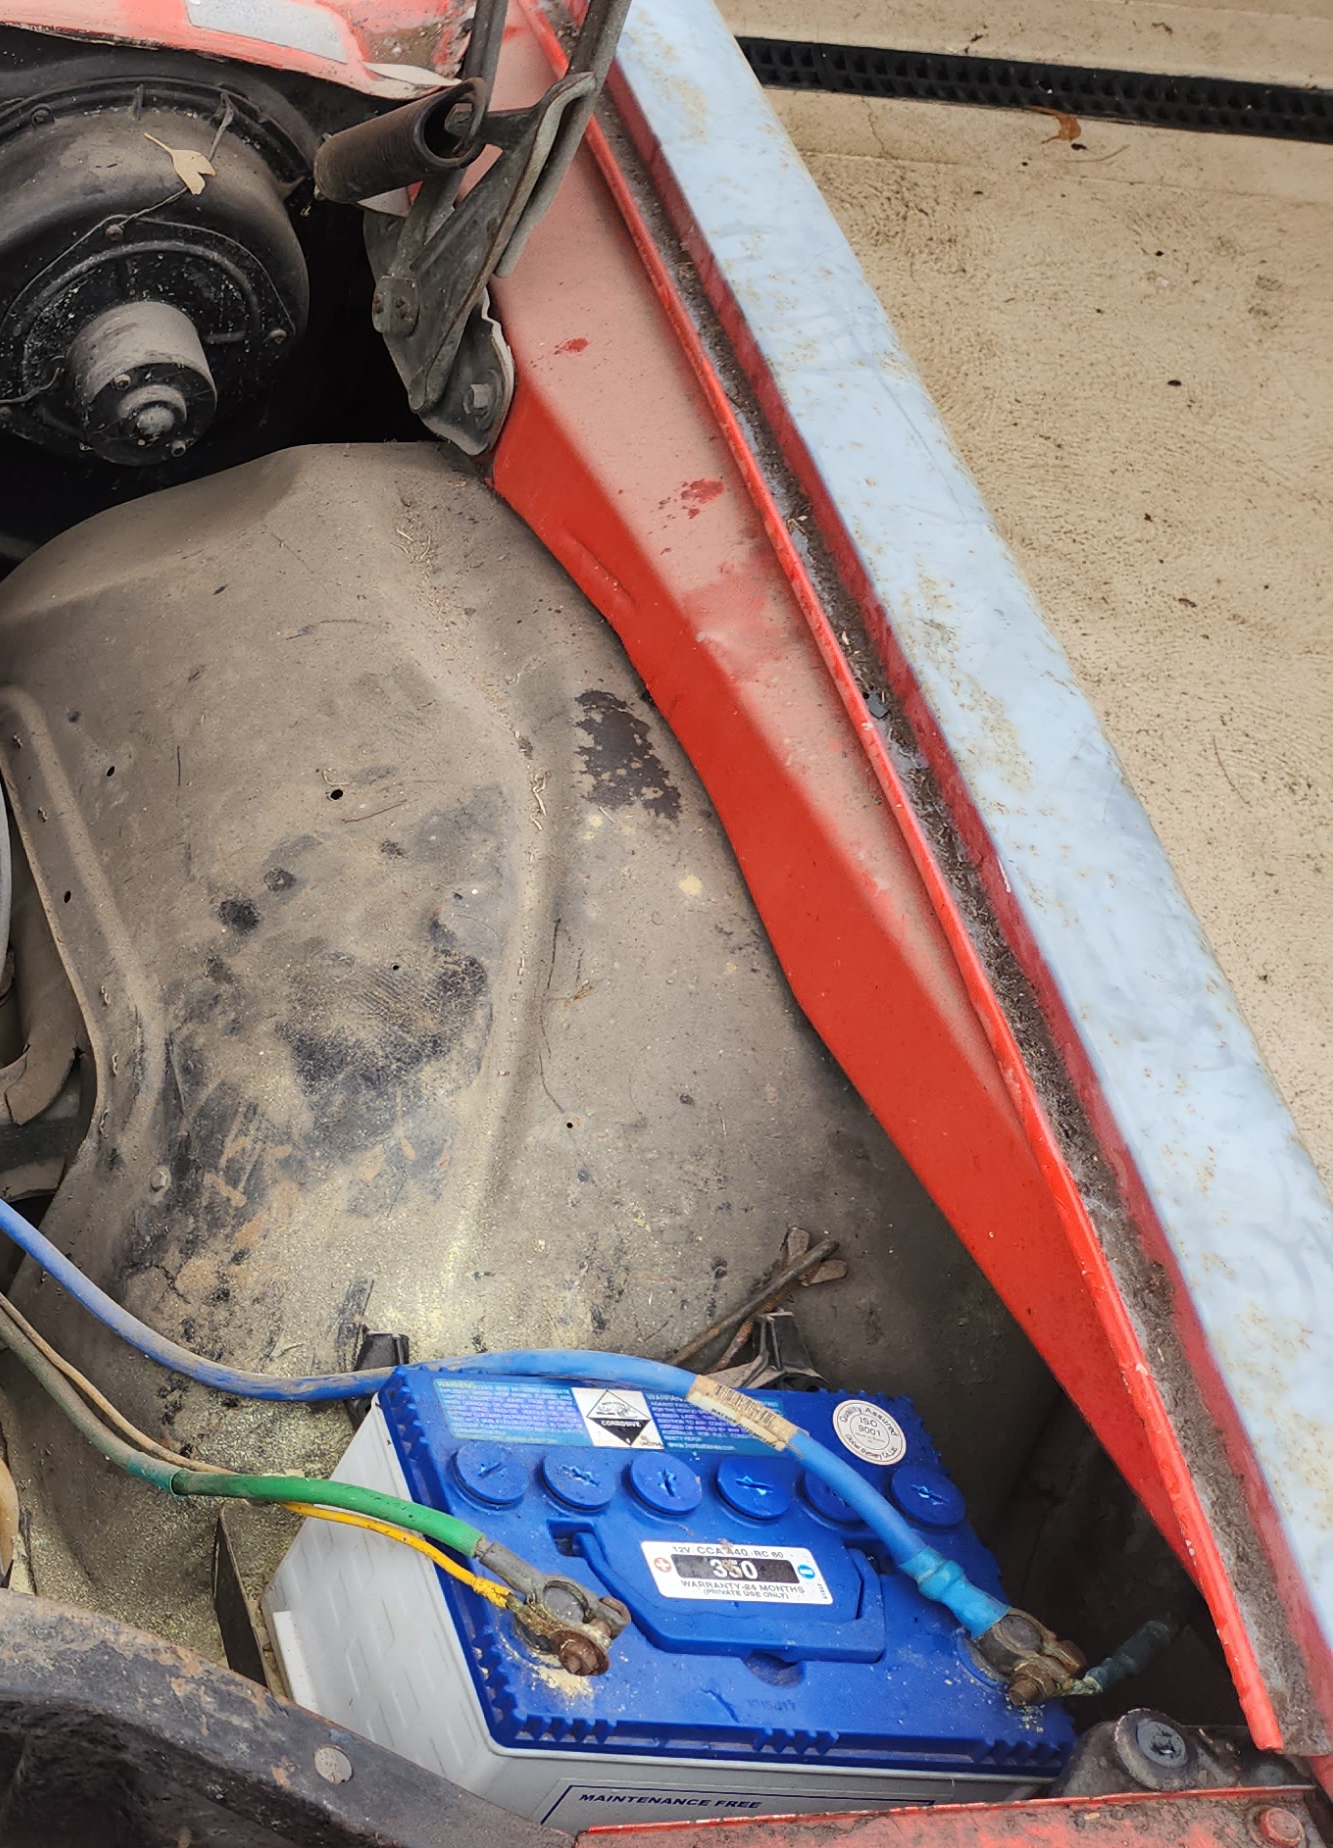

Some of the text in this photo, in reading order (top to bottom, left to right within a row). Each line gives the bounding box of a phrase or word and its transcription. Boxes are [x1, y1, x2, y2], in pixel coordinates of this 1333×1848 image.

[859, 1417, 878, 1428] ISO
[858, 1424, 881, 1437] 9001
[696, 1546, 723, 1555] CCA
[755, 1550, 769, 1558] RC
[703, 1588, 789, 1600] (PRIVATE USE ONLY)
[759, 1584, 805, 1594] MONTHS
[579, 1794, 762, 1809] MAINTENANCE FREE
